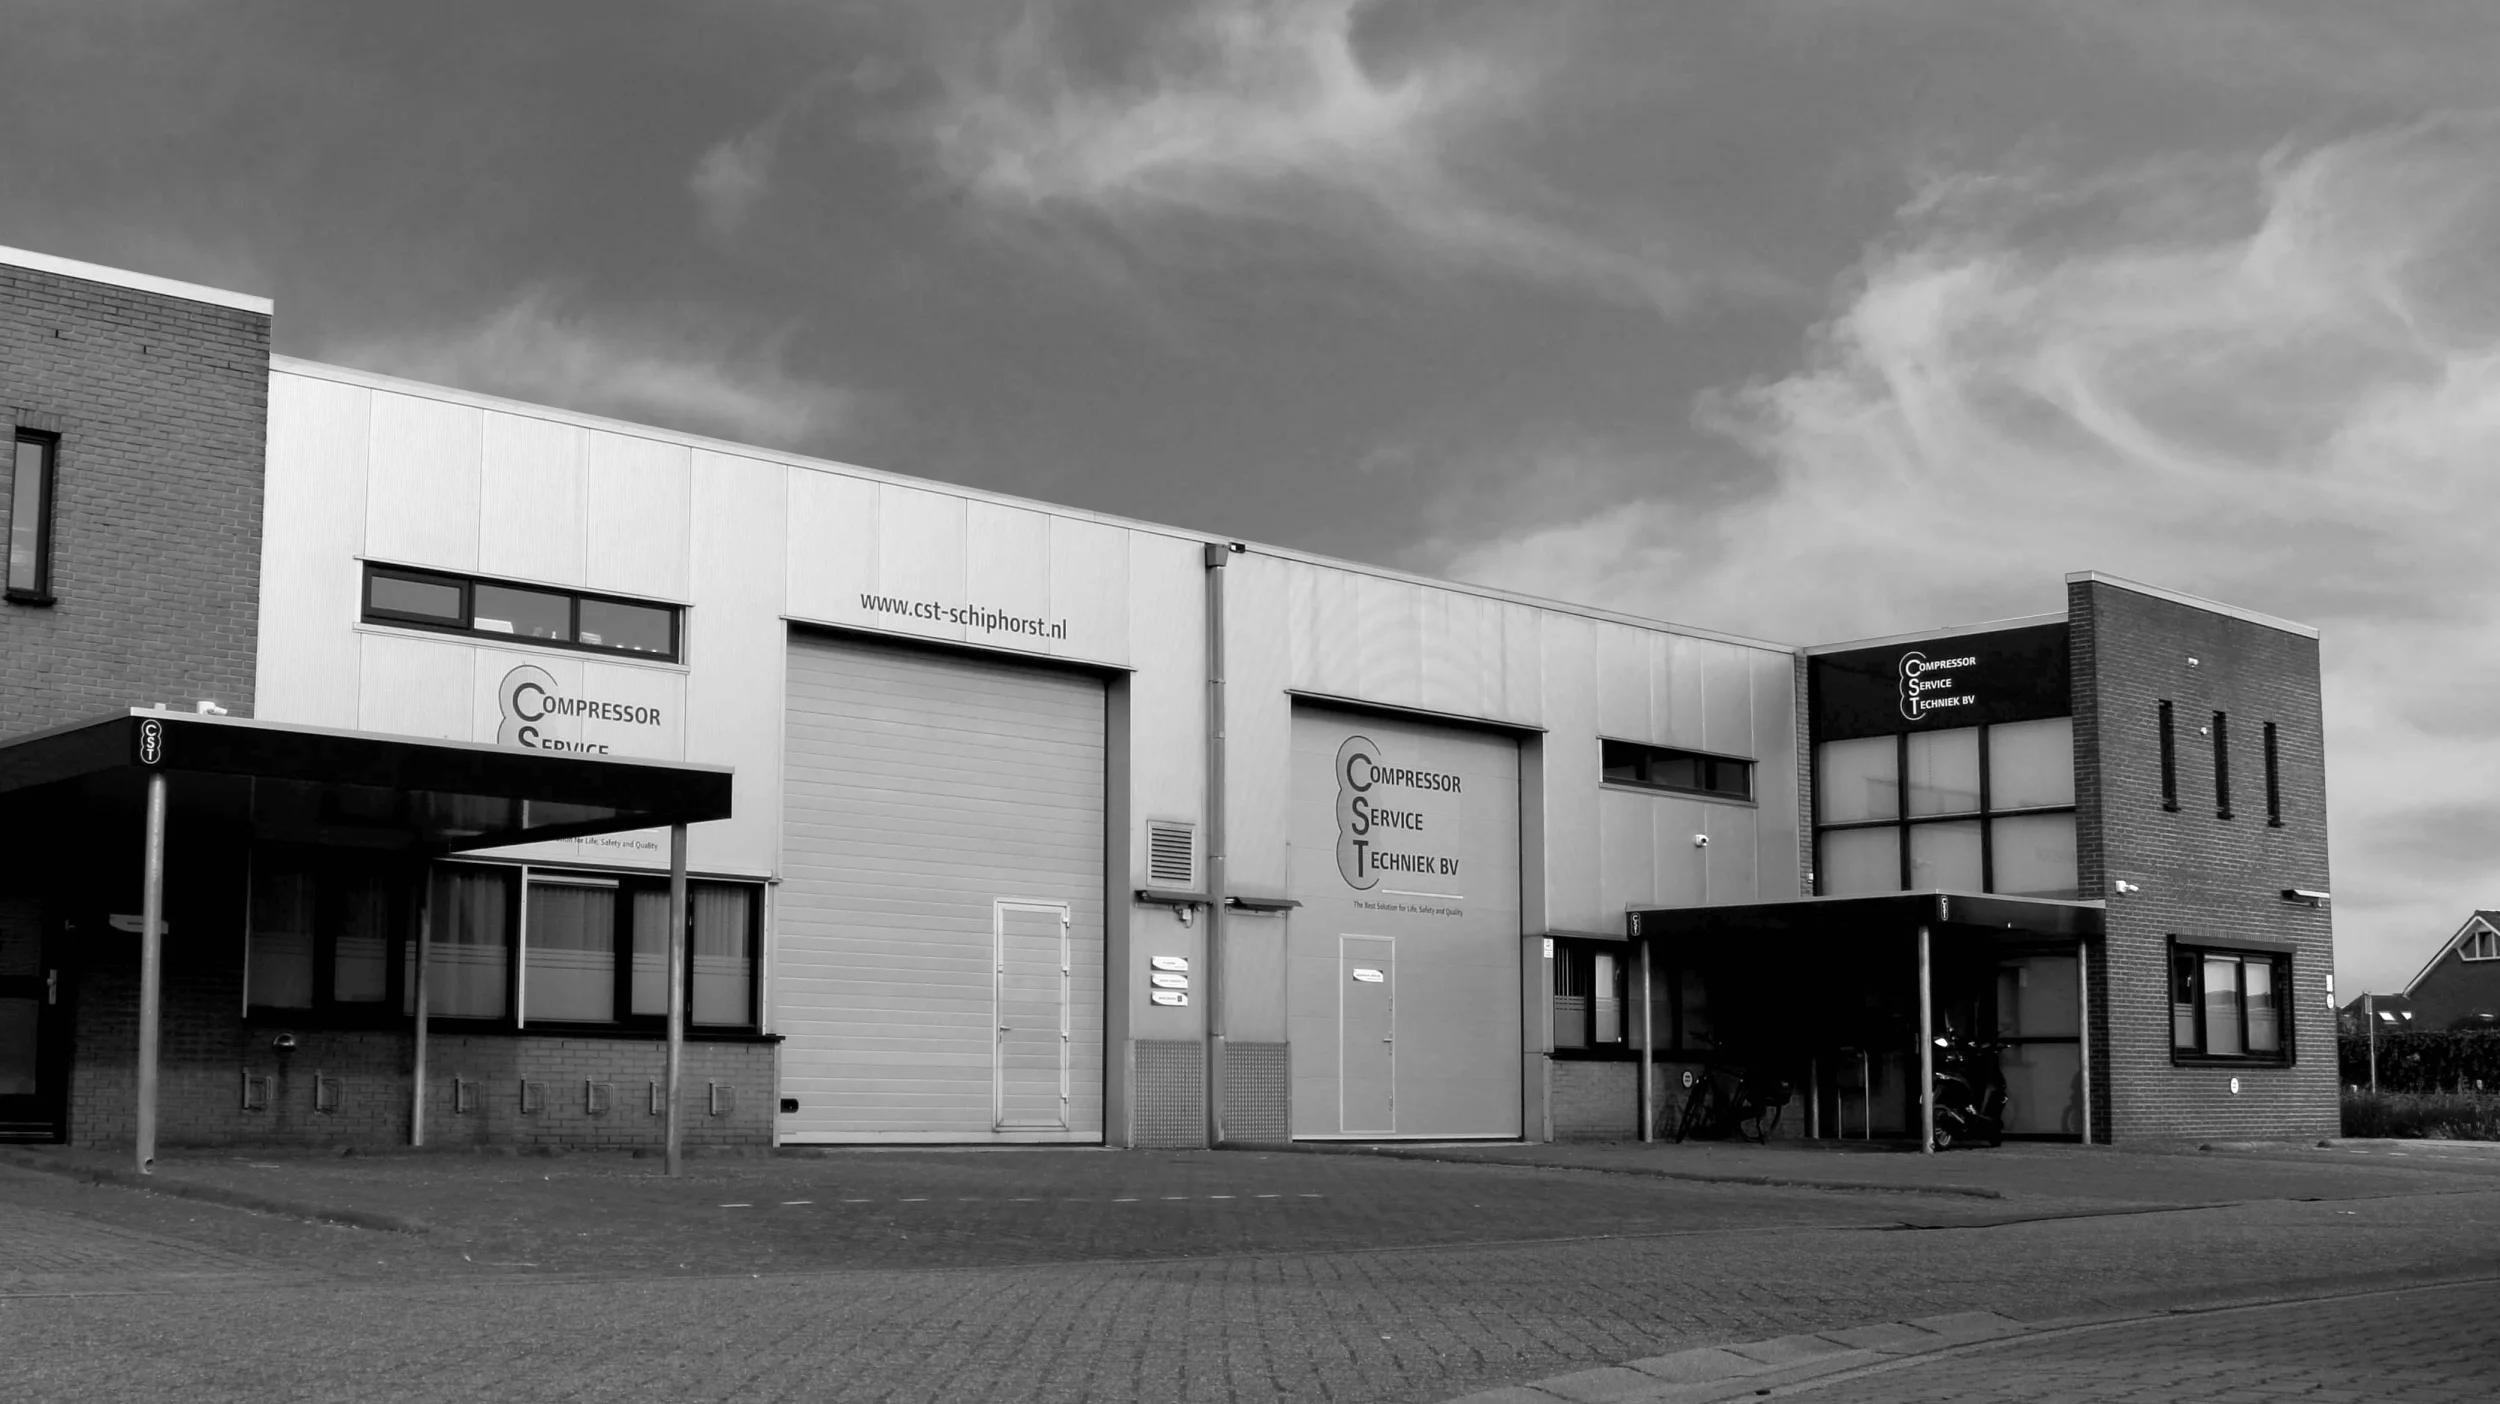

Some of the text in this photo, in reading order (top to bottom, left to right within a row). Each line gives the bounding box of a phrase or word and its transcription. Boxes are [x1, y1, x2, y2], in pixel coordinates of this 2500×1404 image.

[860, 593, 1067, 640] www.cst-schiphorst.nl
[1905, 656, 1976, 677] COMPRESSOR
[512, 682, 661, 726] COMPRESSOR
[1908, 678, 1952, 696] SERVICE
[1909, 695, 1975, 715] TECHNIEK BV
[145, 724, 157, 760] CST
[1346, 753, 1462, 793] COMPRESSOR
[1351, 796, 1423, 836] SERVICE
[601, 839, 620, 848] Safety
[622, 840, 634, 848] and
[636, 841, 658, 850] Quality
[1352, 839, 1459, 878] TECHNIEK BV
[1354, 901, 1364, 909] The
[1364, 902, 1376, 910] Best
[1377, 903, 1398, 911] Solution
[1399, 904, 1407, 912] for
[1419, 906, 1435, 915] Safety
[1446, 909, 1463, 917] Quality
